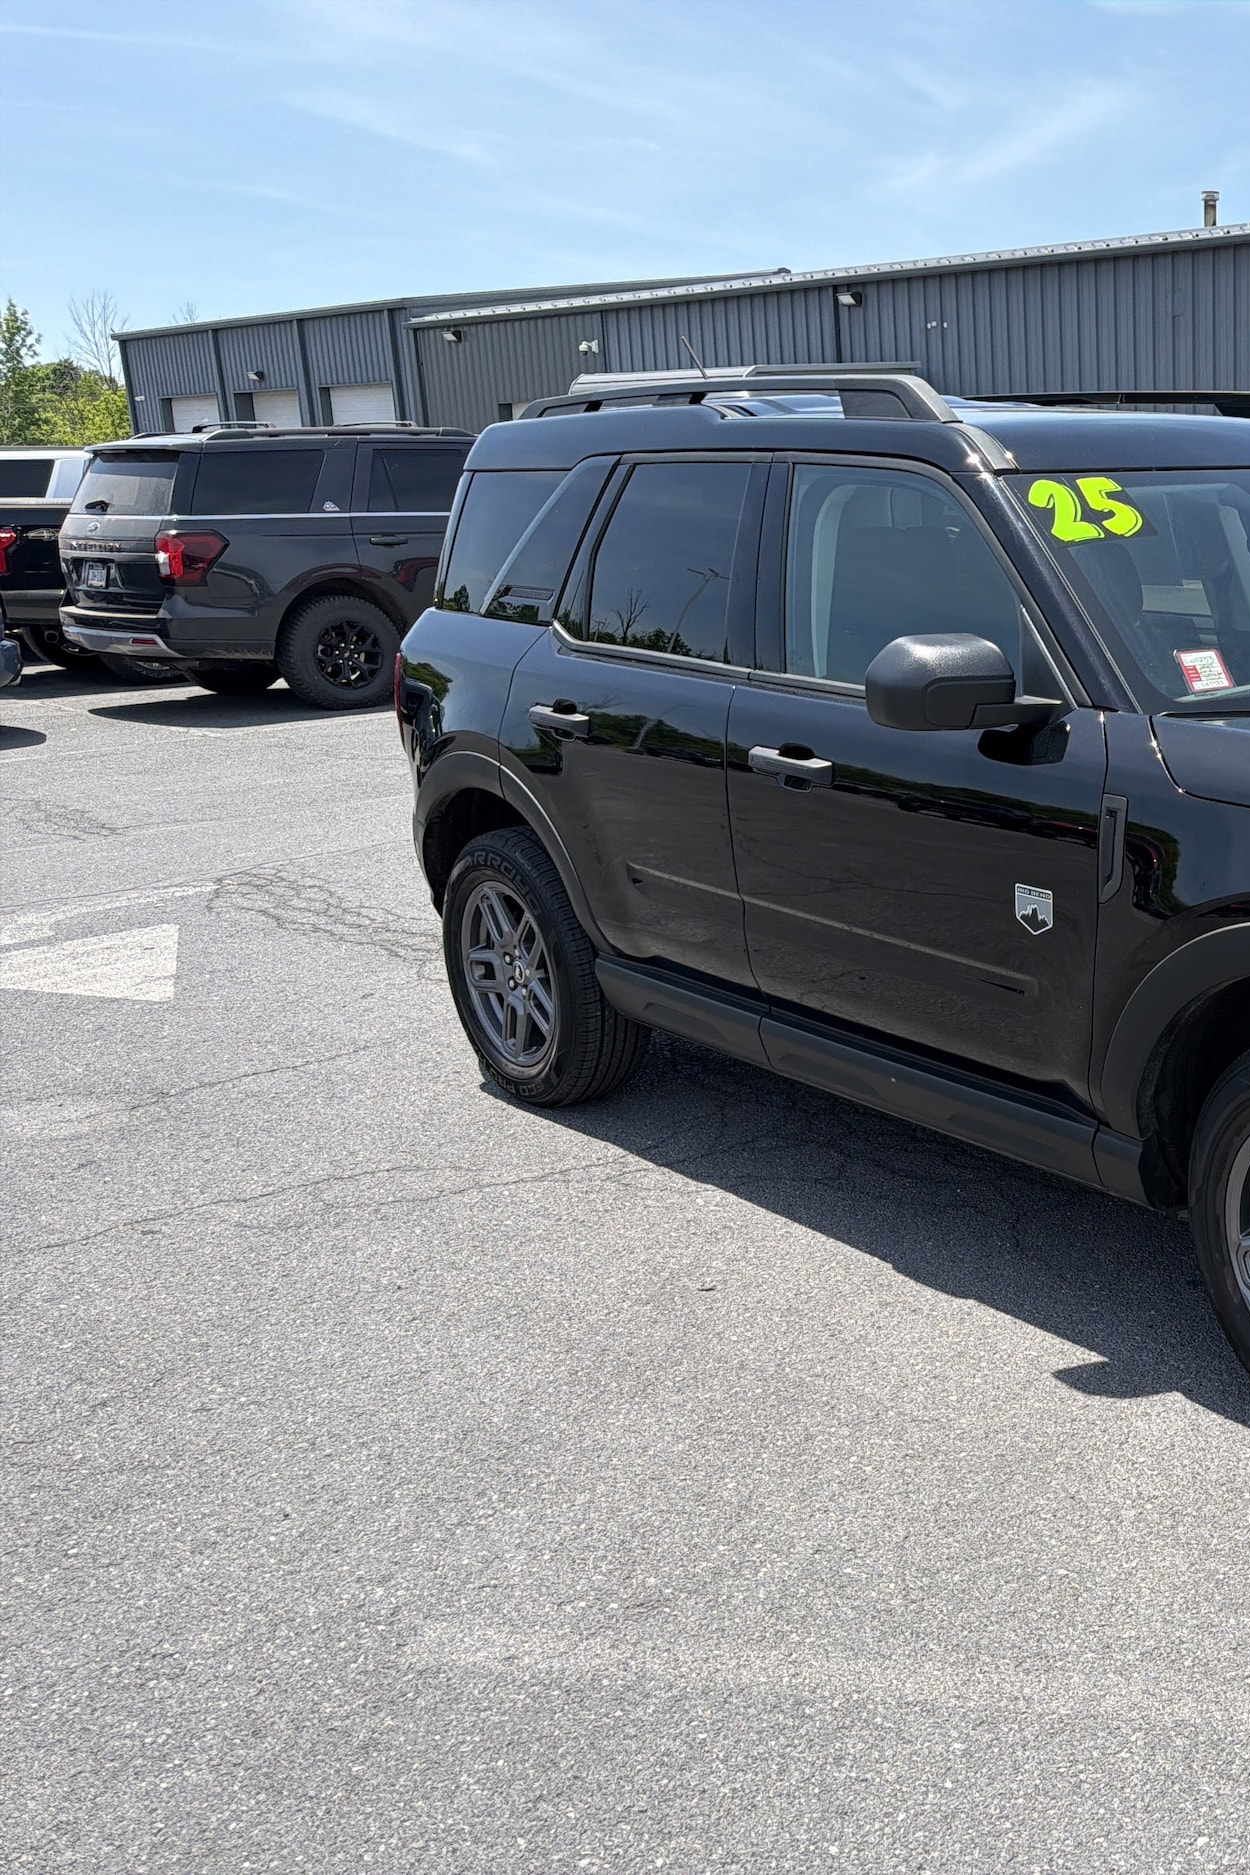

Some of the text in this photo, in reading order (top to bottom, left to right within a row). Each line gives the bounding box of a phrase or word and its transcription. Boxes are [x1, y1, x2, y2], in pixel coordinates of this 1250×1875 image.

[1028, 477, 1143, 542] 25
[1017, 887, 1051, 900] BIG BEND
